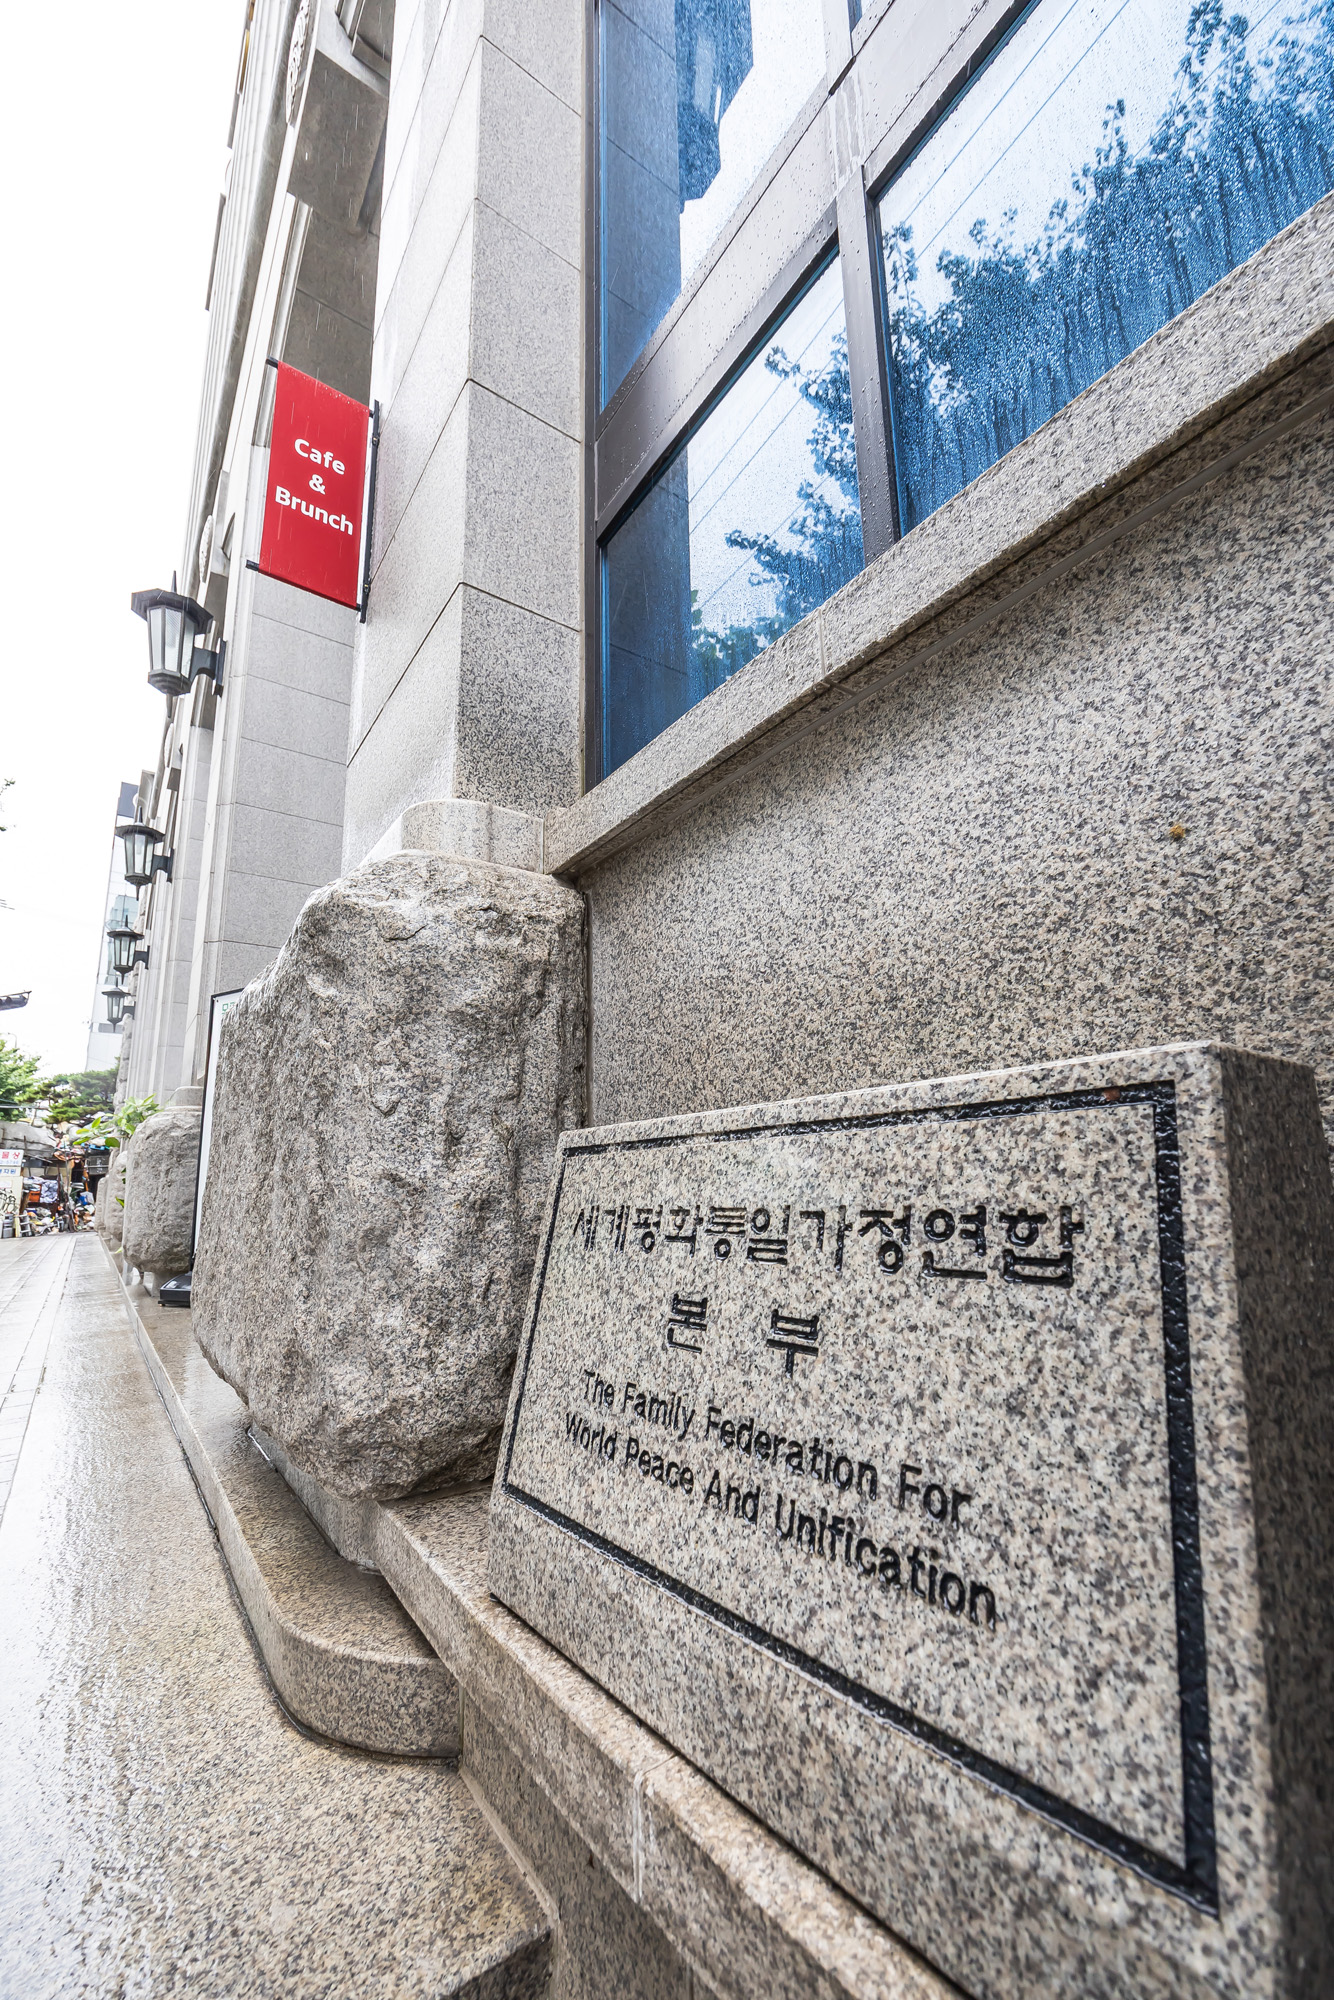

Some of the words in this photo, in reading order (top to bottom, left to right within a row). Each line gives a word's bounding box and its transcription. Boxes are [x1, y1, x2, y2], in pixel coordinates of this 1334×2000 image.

[294, 438, 345, 475] Cafe
[308, 474, 326, 495] &
[275, 485, 354, 536] Brunch
[573, 1204, 1085, 1289] 세계평화통일가정연합
[584, 1369, 615, 1408] The
[621, 1381, 696, 1442] Family
[705, 1405, 878, 1501] Federation
[899, 1463, 973, 1530] For
[565, 1412, 619, 1462] World
[625, 1436, 694, 1496] Peace
[704, 1469, 762, 1527] And
[775, 1492, 998, 1632] Unification
